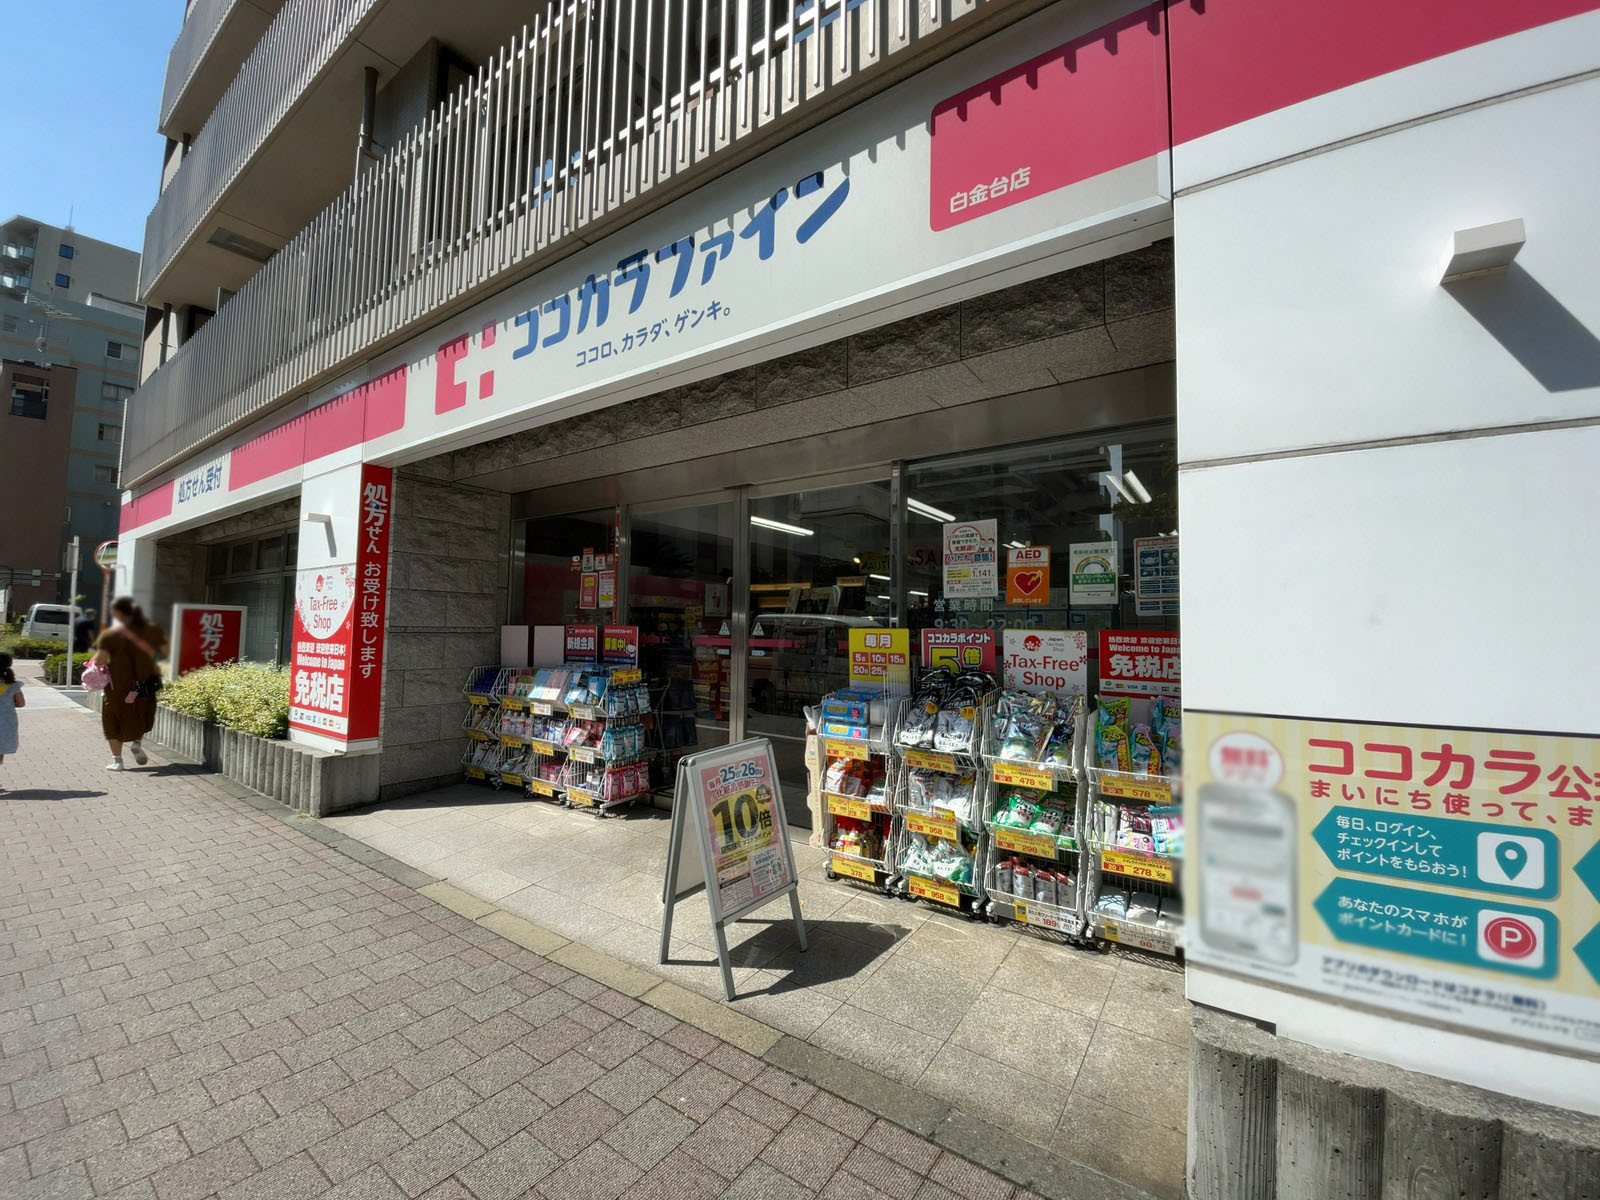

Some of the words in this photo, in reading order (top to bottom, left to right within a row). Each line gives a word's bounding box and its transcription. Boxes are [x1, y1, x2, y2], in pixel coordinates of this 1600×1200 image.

[950, 166, 1031, 213] 白金台店
[512, 171, 850, 360] ココカラファイン
[575, 300, 731, 368] ココロ、カラダ、ゲンキ。
[178, 464, 223, 505] 処方せん受付
[363, 482, 388, 555] 処方せん
[1016, 550, 1042, 560] AED
[309, 596, 338, 611] Tax-Free
[313, 614, 332, 633] Shop
[358, 561, 381, 679] お受け致します
[567, 636, 595, 651] 新規会員
[865, 633, 892, 649] 毎月
[927, 632, 991, 644] ココカラポイント
[1109, 644, 1149, 653] Welcome
[1151, 645, 1160, 653] to
[1009, 654, 1080, 672] Tax-Free
[293, 669, 345, 713] 免税店
[1022, 672, 1066, 689] Shop
[1019, 776, 1036, 786] 478
[1308, 738, 1600, 801] ココカラ公
[1132, 789, 1151, 798] 578
[1309, 779, 1594, 827] まいにち使って、ま
[1336, 815, 1438, 840] 毎日、ログイン、
[1337, 832, 1443, 858] チェックインして
[850, 868, 863, 878] 378
[1133, 866, 1152, 877] 278
[1337, 848, 1467, 878] ポイントをもらおう!
[1042, 918, 1057, 927] 189
[1337, 895, 1468, 929] あなたのスマホが
[1338, 911, 1467, 947] ポイントカードに!
[1500, 926, 1523, 949] P
